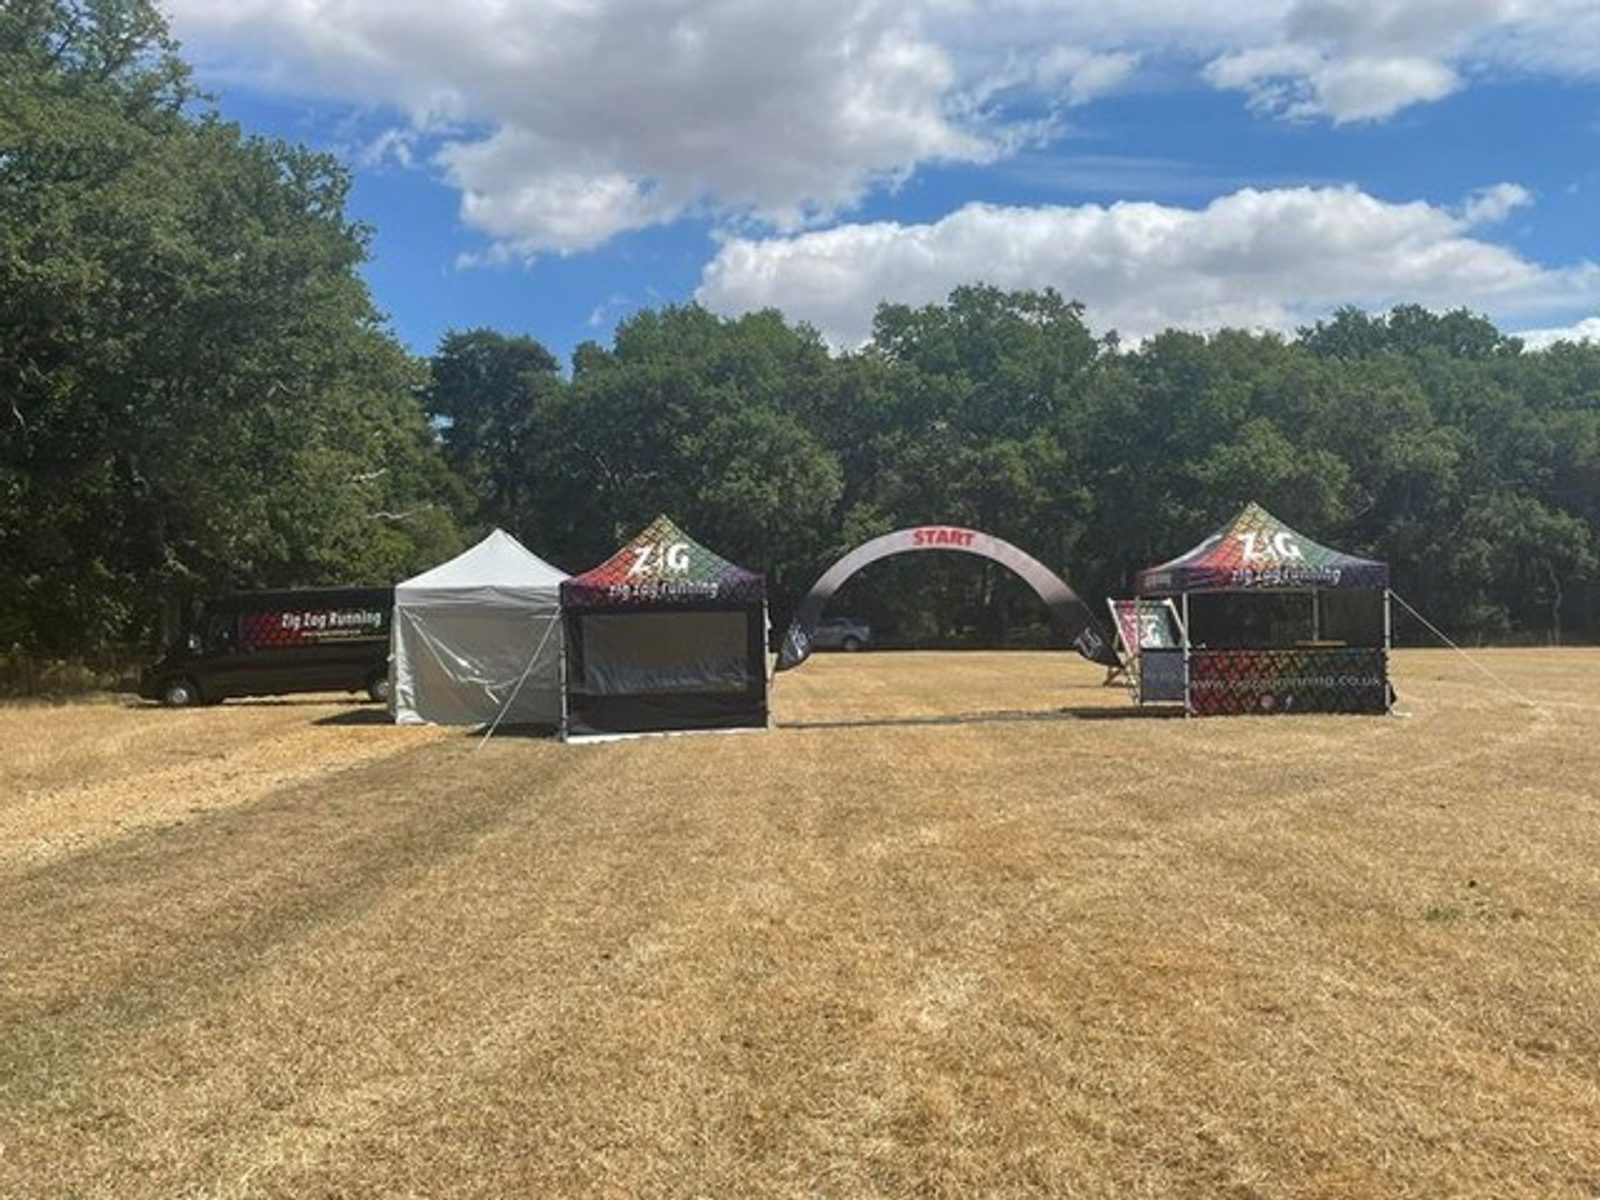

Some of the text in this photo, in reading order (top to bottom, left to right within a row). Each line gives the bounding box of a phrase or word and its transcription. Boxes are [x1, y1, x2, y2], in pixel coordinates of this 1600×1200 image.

[912, 529, 975, 547] START
[1283, 565, 1342, 586] running
[661, 579, 719, 599] running
[329, 609, 382, 628] Running
